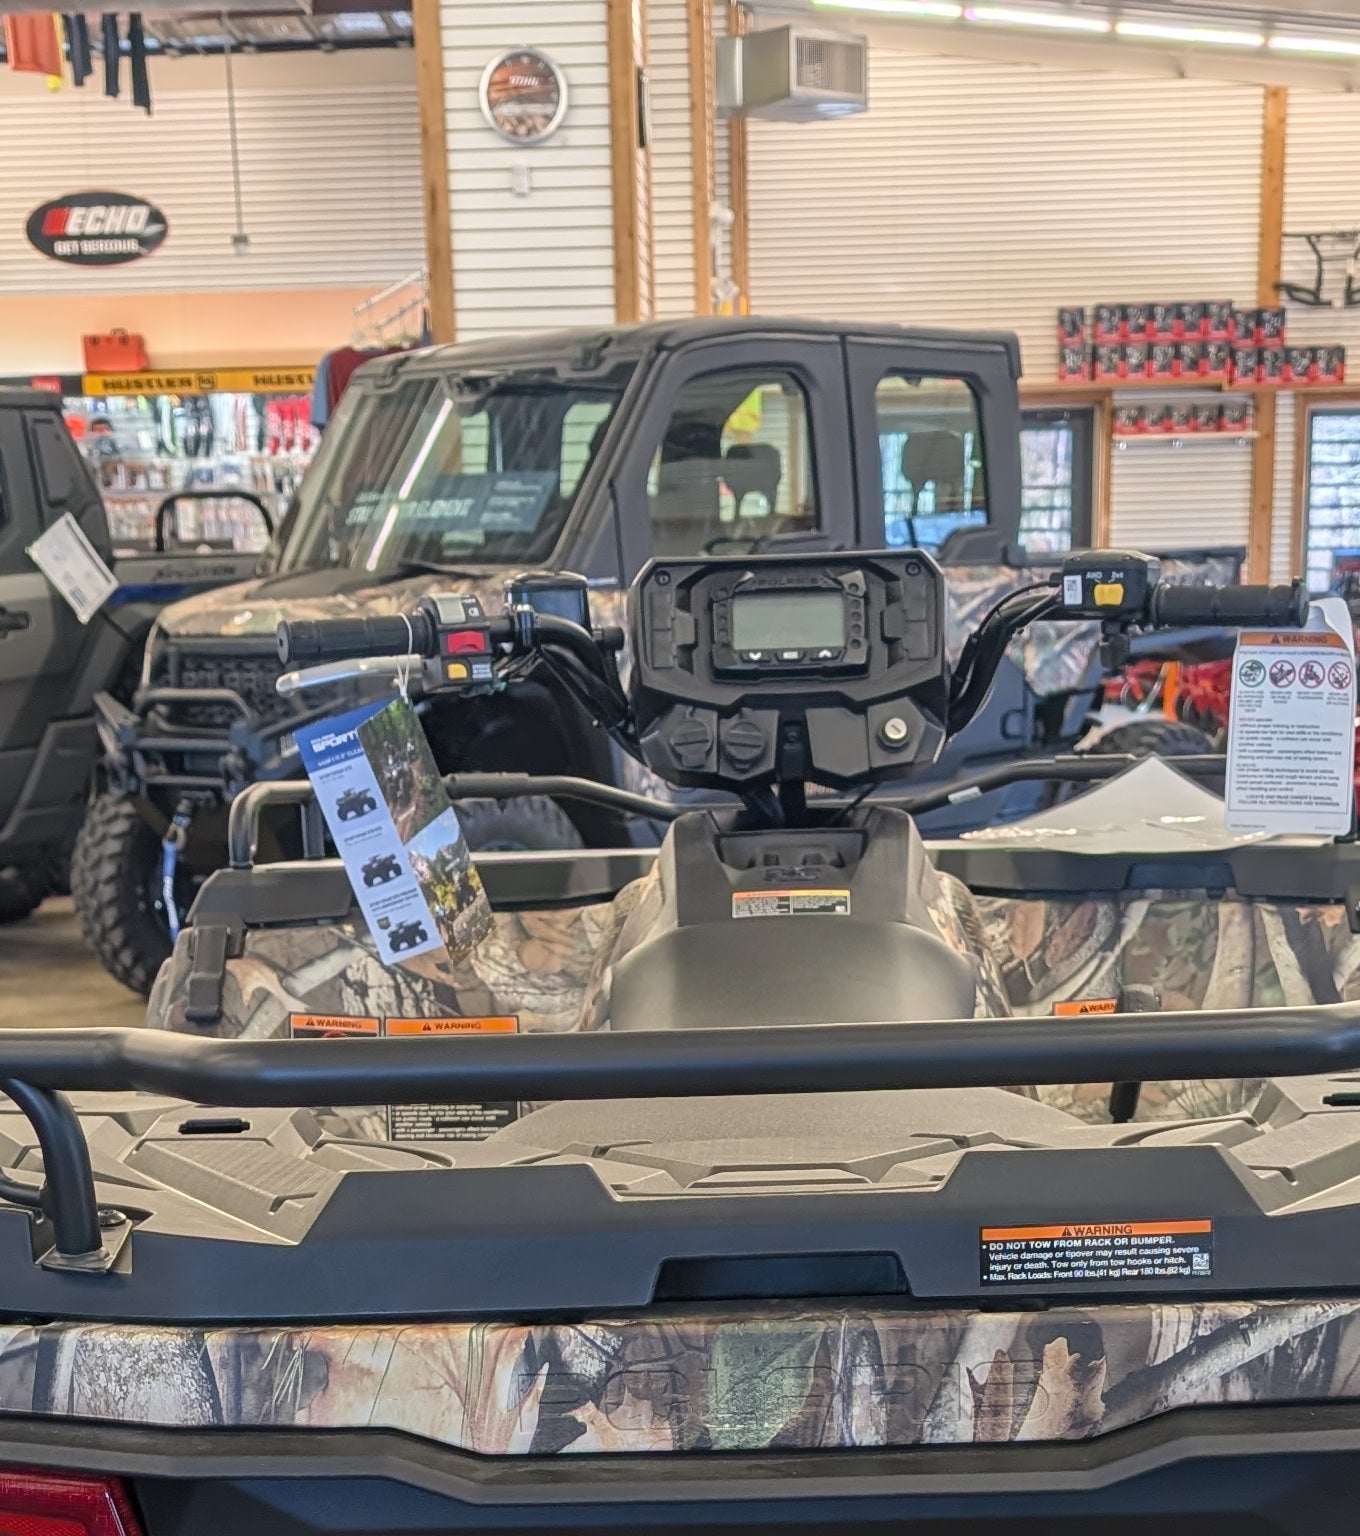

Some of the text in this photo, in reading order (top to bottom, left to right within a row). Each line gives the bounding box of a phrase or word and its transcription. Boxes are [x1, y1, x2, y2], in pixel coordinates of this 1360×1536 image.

[65, 205, 150, 236] ECHO
[102, 377, 193, 391] HUSTLER
[1282, 635, 1328, 644] WARNING
[315, 1019, 362, 1030] WARNING
[434, 1021, 482, 1031] WARNING
[1073, 1225, 1132, 1236] WARNING
[990, 1236, 1175, 1251] DO NOT TOW FROM RACK OR BUMPER.
[990, 1252, 1018, 1261] Vehicle
[1020, 1251, 1053, 1261] damage
[1066, 1250, 1093, 1260] tipover
[1096, 1250, 1112, 1259] may
[1115, 1248, 1137, 1256] result
[1139, 1247, 1170, 1256] causing
[990, 1262, 1011, 1272] injury
[1024, 1260, 1049, 1269] death.
[1051, 1260, 1068, 1269] Tow
[1071, 1259, 1087, 1269] only
[1090, 1259, 1108, 1267] from
[1110, 1258, 1125, 1266] tow
[1127, 1257, 1152, 1265] hooks
[1164, 1256, 1186, 1264] hitch.
[990, 1272, 1006, 1280] Max.
[1008, 1272, 1027, 1280] Rack
[1028, 1271, 1052, 1279] Loads:
[1054, 1270, 1073, 1278] Front
[1122, 1268, 1139, 1276] Rear
[518, 1360, 1050, 1434] POLARIS
